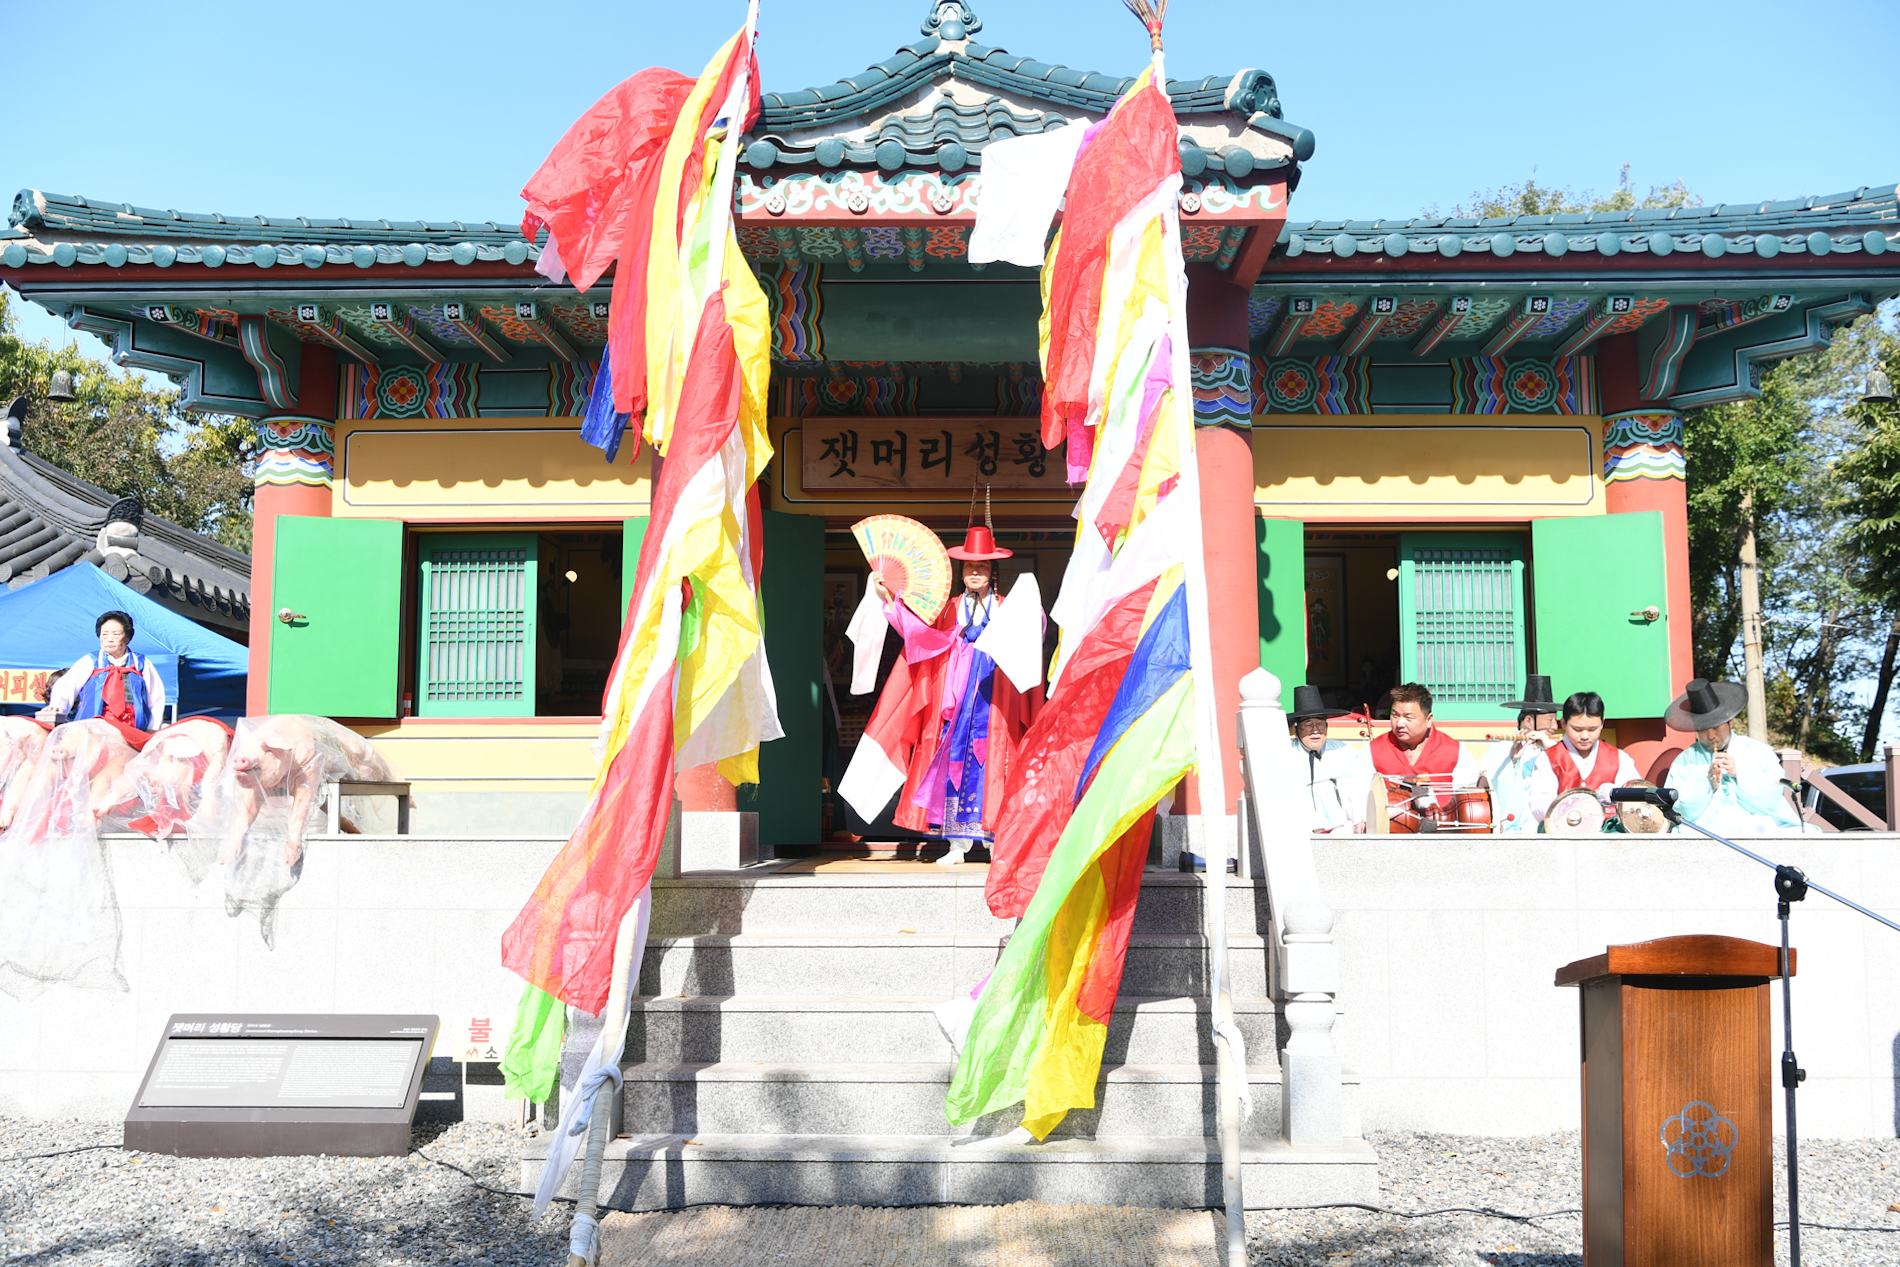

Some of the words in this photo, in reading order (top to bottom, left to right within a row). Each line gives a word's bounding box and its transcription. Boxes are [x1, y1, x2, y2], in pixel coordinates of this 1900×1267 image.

[819, 429, 1068, 478] 잿머리성황
[468, 1017, 493, 1043] 불
[484, 1046, 498, 1059] 소
